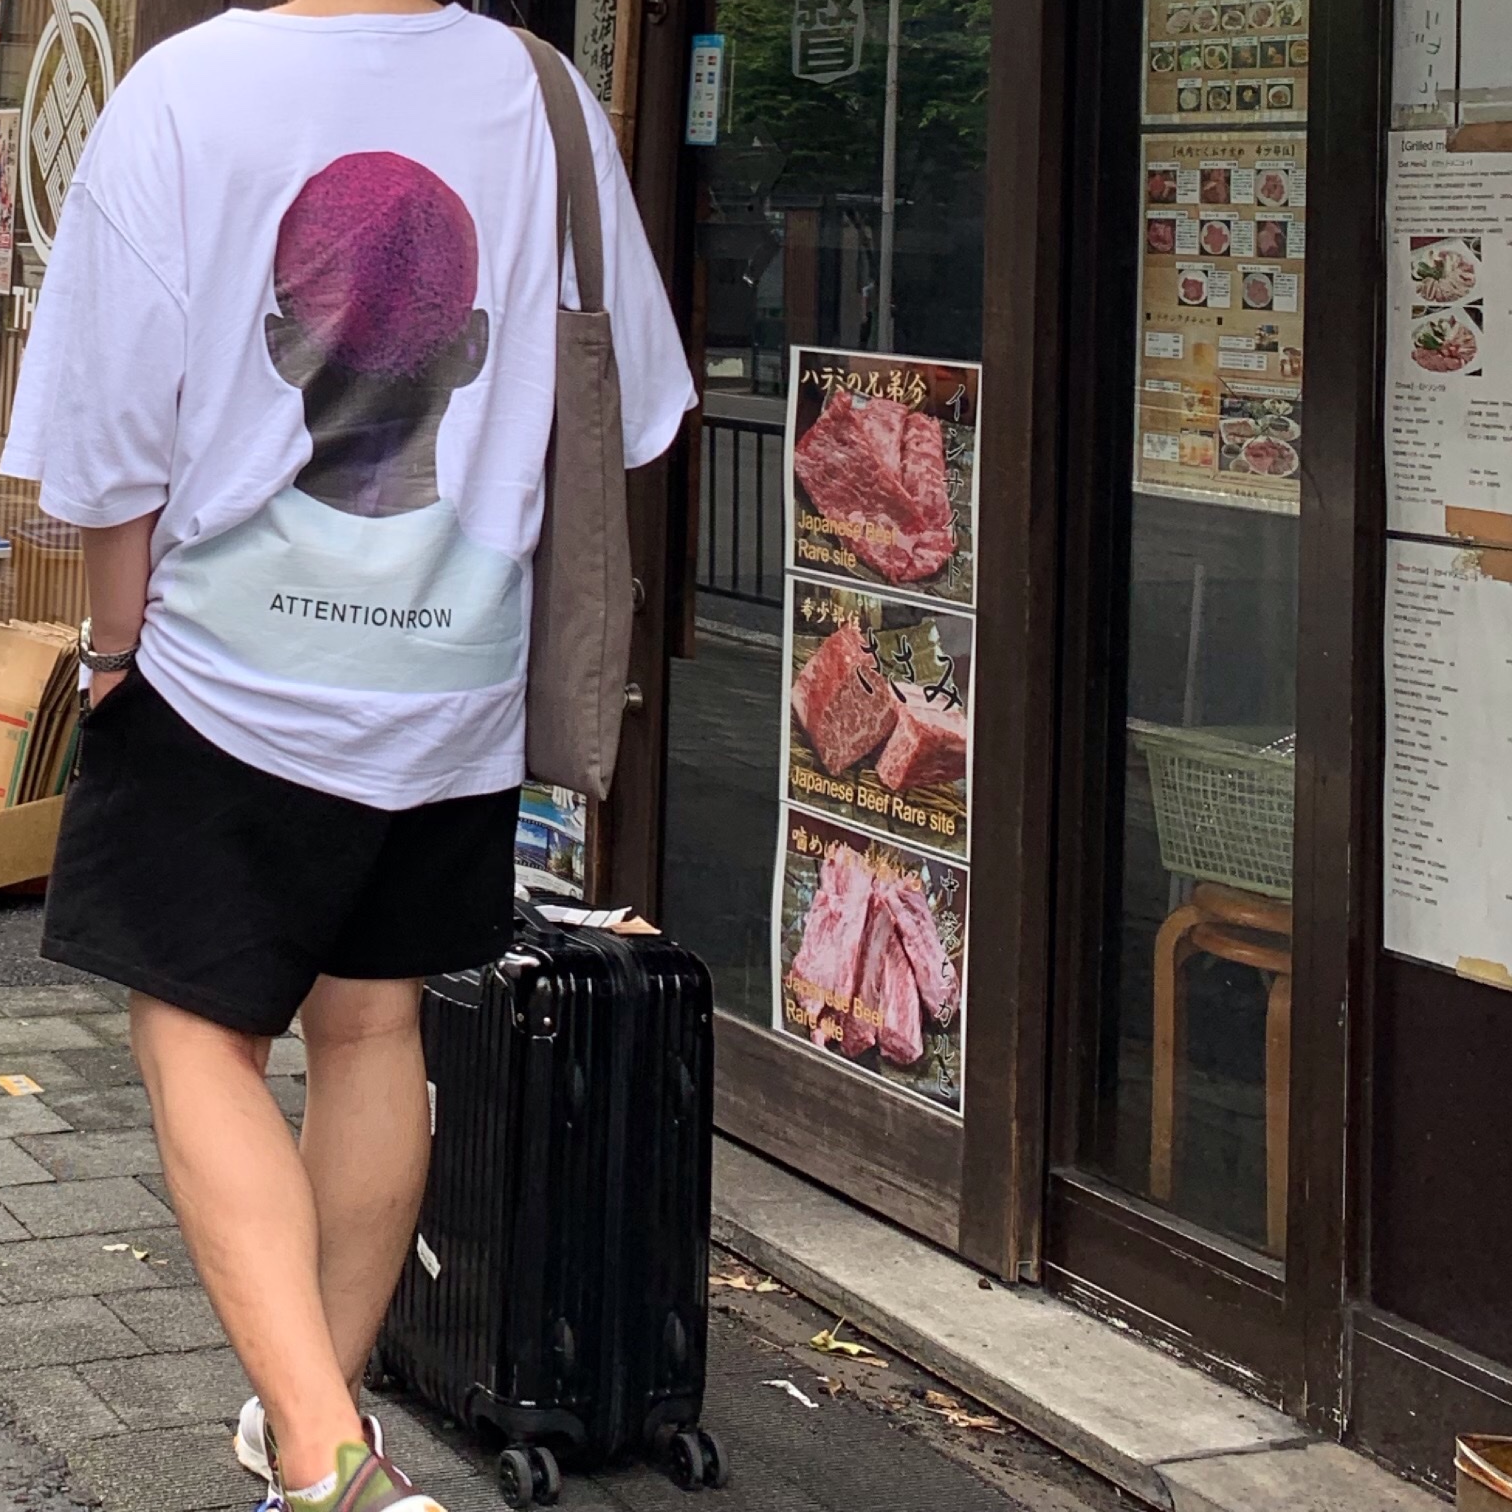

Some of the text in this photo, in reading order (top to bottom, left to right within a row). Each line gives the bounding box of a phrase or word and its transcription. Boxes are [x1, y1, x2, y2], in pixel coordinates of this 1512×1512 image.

[12, 286, 38, 330] TH
[800, 366, 928, 404] ハラミの兄弟分
[942, 383, 967, 590] インサイド
[797, 511, 898, 546] Japanese Beef
[798, 540, 857, 568] Rare site
[269, 592, 452, 629] ATTENTIONROW
[800, 596, 862, 631] 希少部位
[855, 627, 963, 712] ささみ
[791, 765, 956, 837] Japanese Beef Rare site
[785, 969, 886, 1028] Japanese Beef
[785, 998, 818, 1030] Rare
